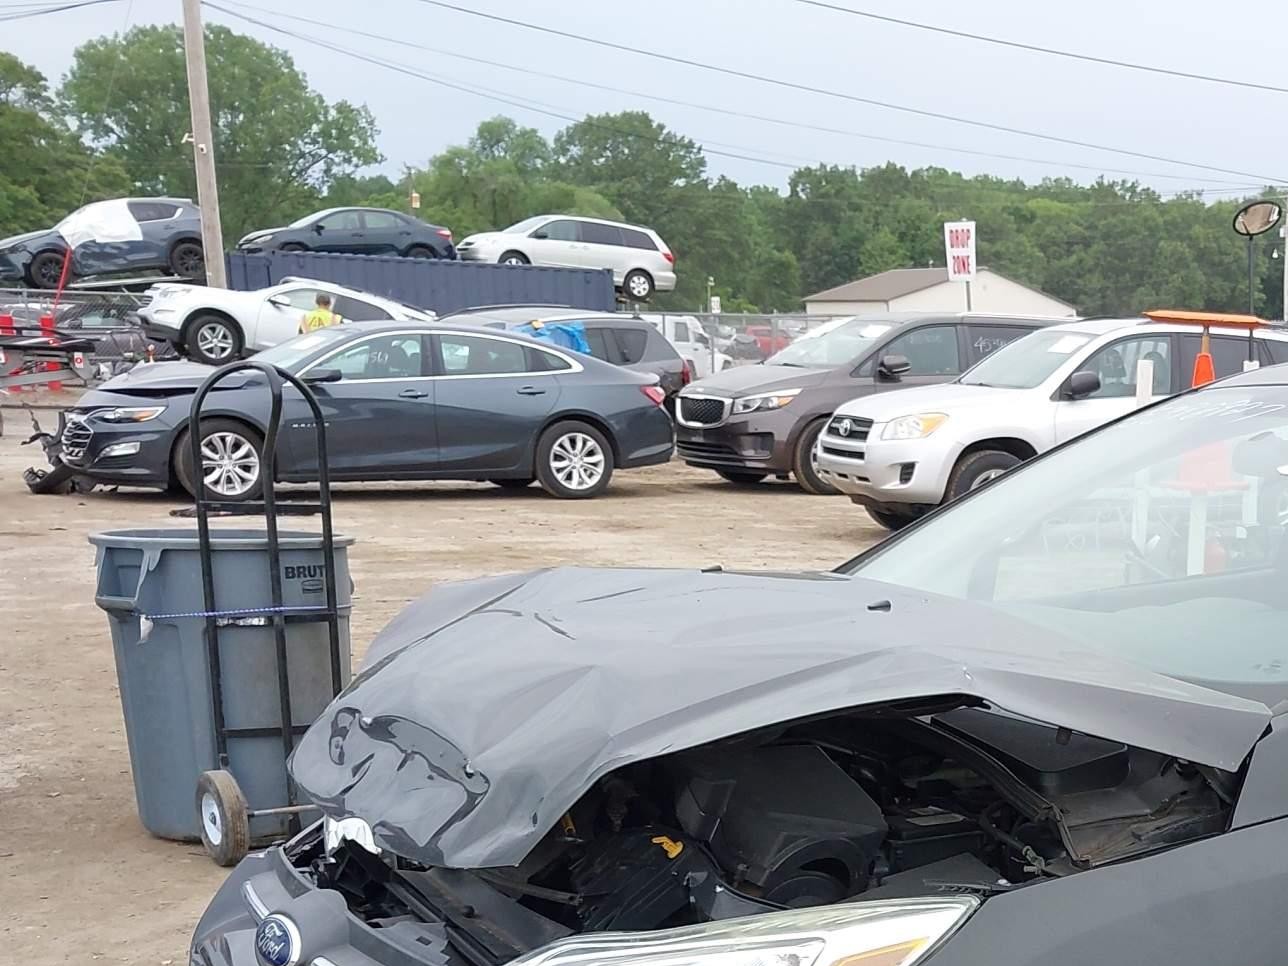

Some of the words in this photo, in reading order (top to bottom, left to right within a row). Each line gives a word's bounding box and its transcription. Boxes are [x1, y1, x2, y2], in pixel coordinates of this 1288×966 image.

[949, 228, 971, 248] DROP
[952, 255, 971, 274] ZONE
[284, 565, 326, 579] BRUT
[258, 922, 286, 961] Ford
